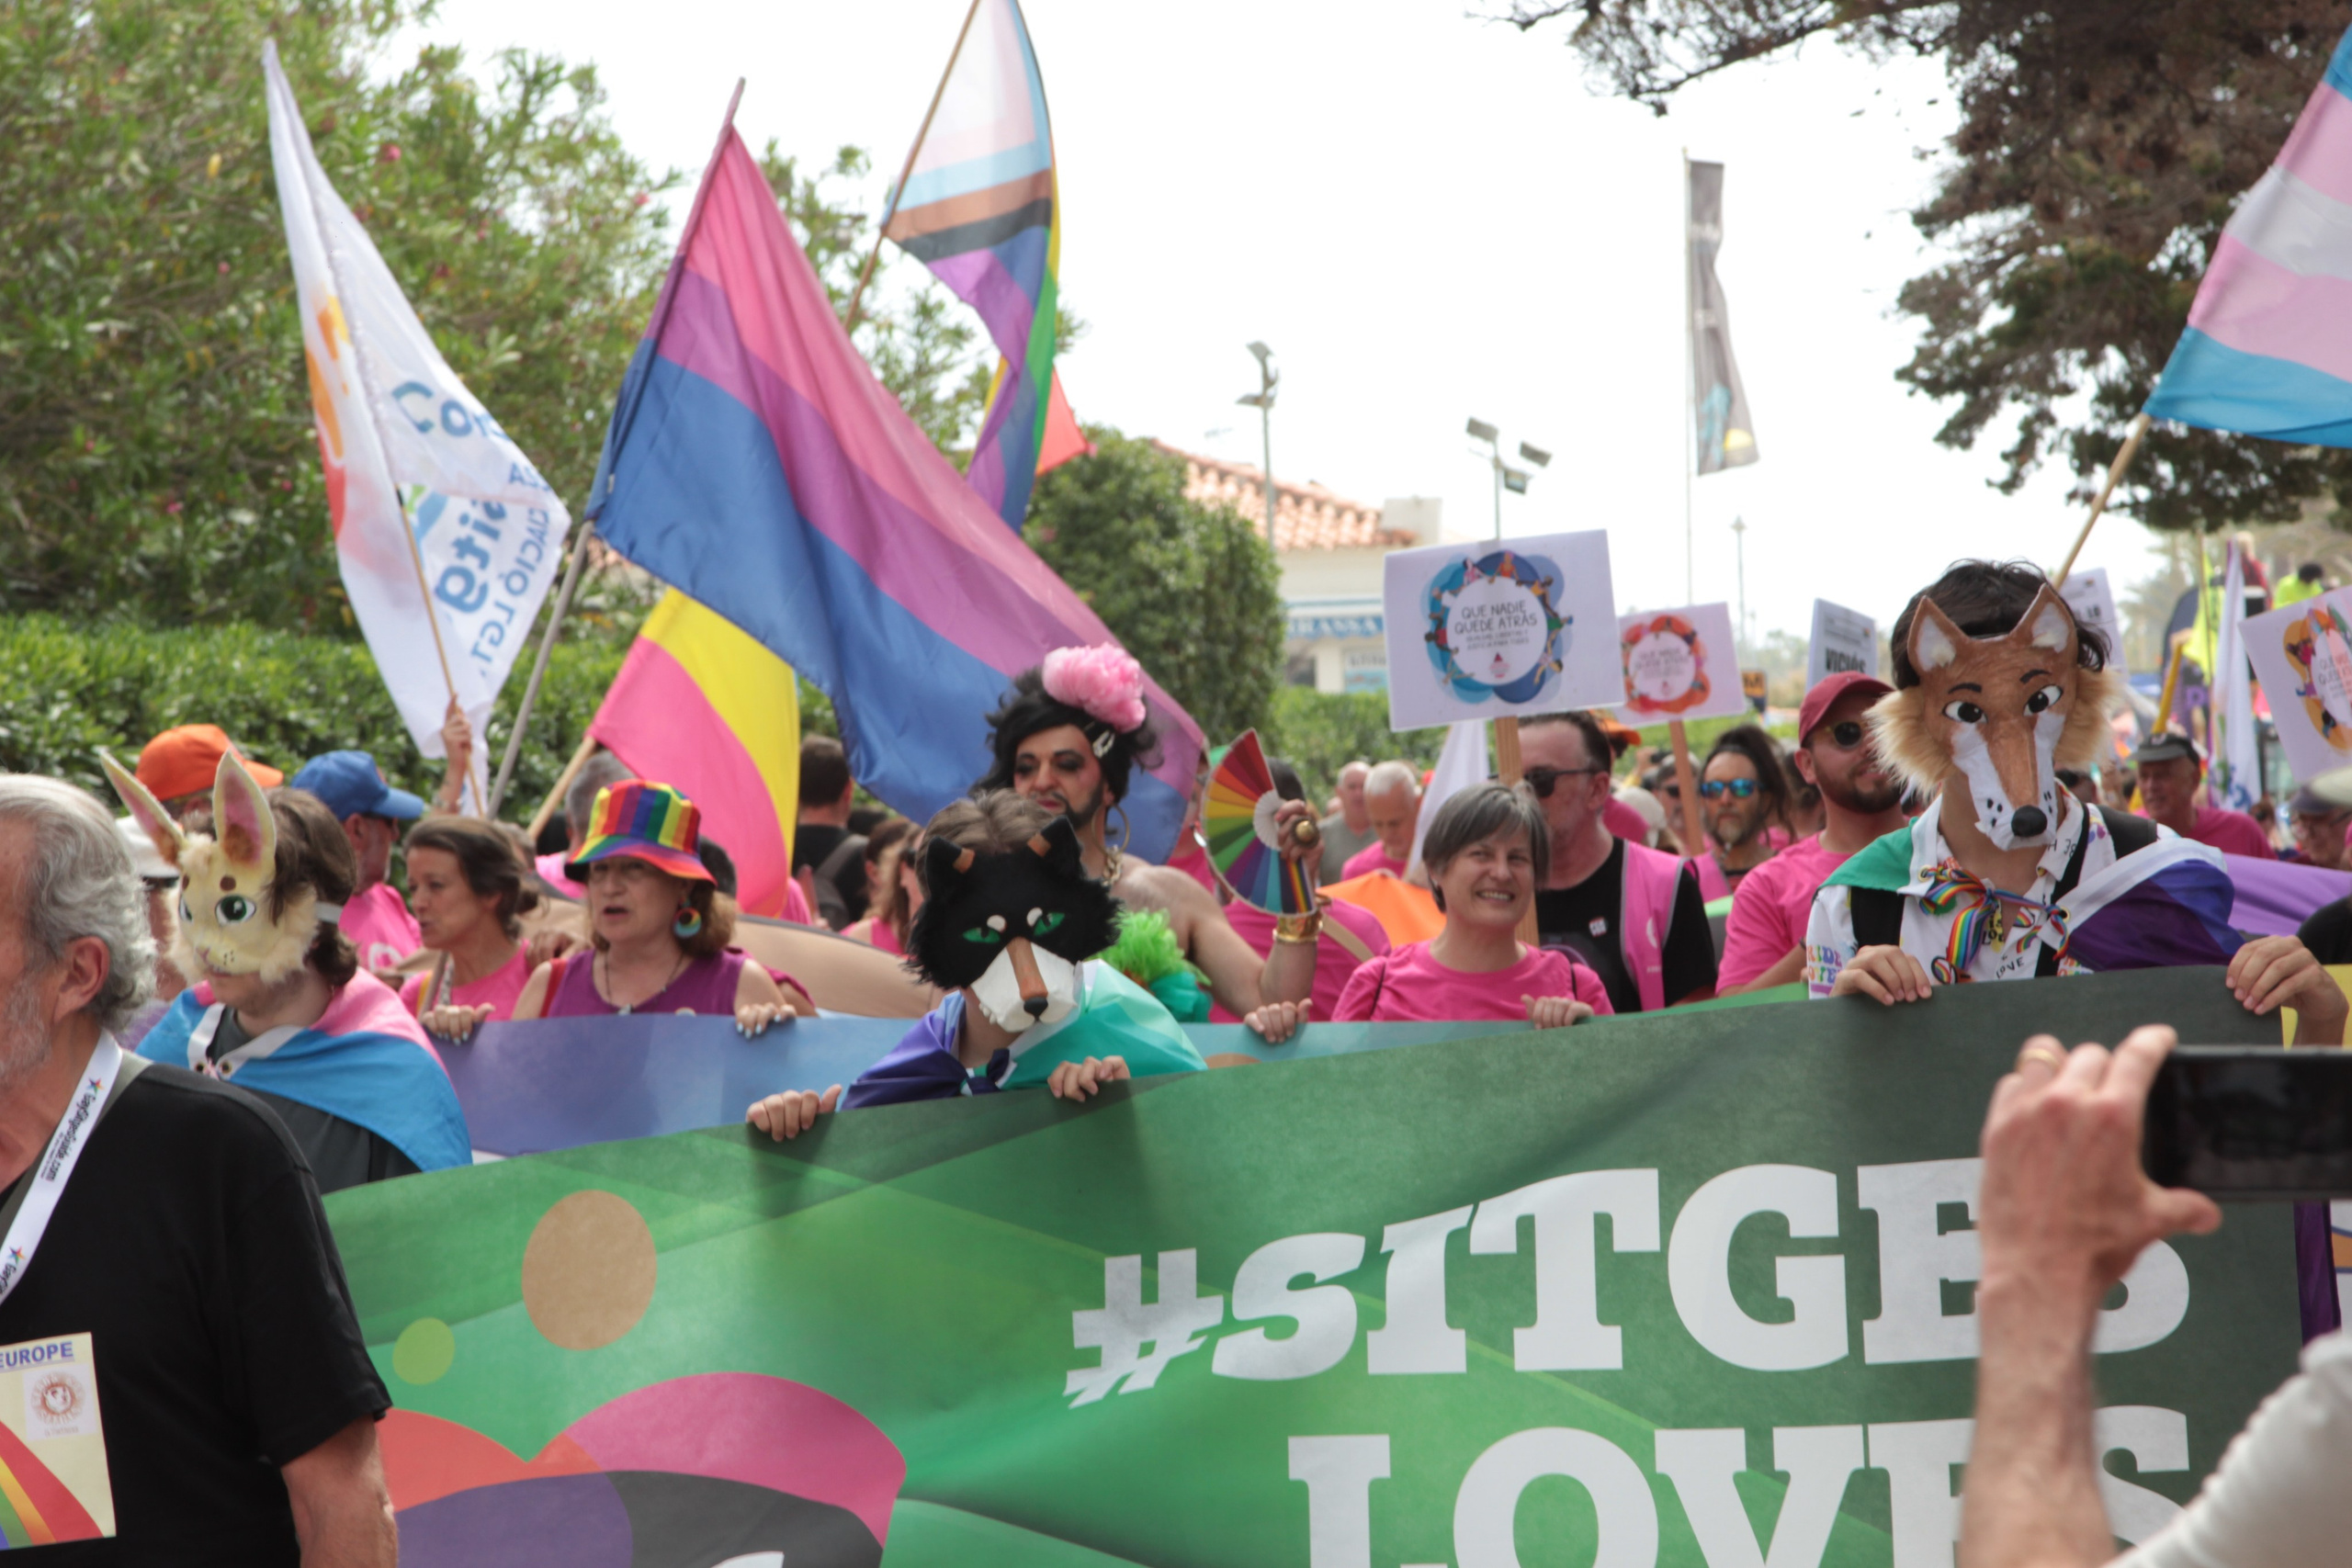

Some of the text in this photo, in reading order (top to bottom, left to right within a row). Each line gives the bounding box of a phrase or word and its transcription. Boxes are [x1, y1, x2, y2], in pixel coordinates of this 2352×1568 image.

[1462, 600, 1527, 620] QUE NADIE
[1454, 617, 1495, 635] QUEDE
[1996, 956, 2025, 979] LOVE
